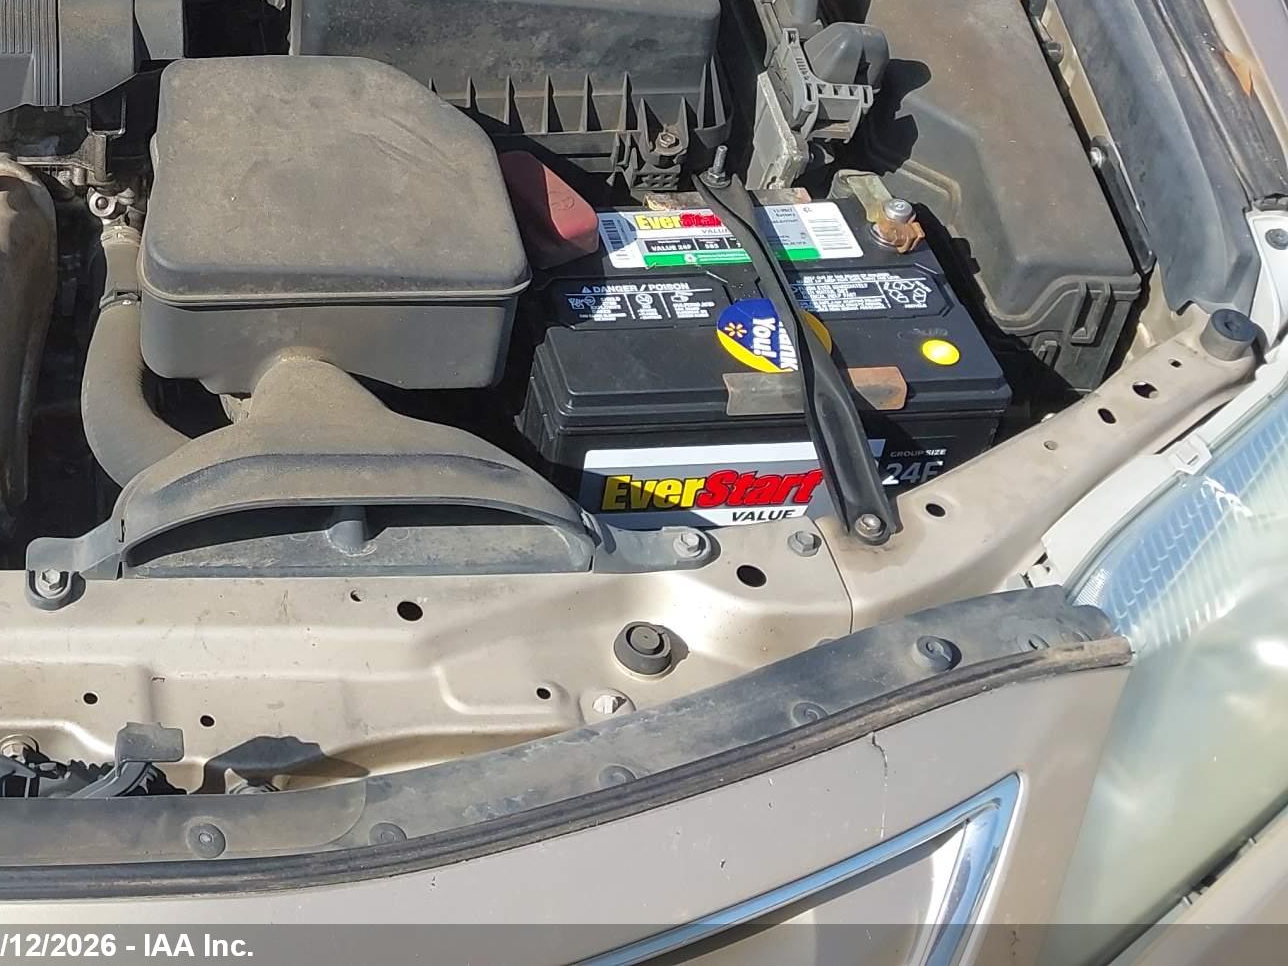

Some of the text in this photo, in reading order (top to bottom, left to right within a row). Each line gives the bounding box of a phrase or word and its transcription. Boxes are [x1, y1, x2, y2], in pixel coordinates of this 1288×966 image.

[592, 285, 638, 293] DANGER
[647, 282, 691, 291] POISON
[752, 317, 777, 358] You!
[890, 448, 947, 458] GROUP SIZE
[601, 468, 824, 511] EverStart
